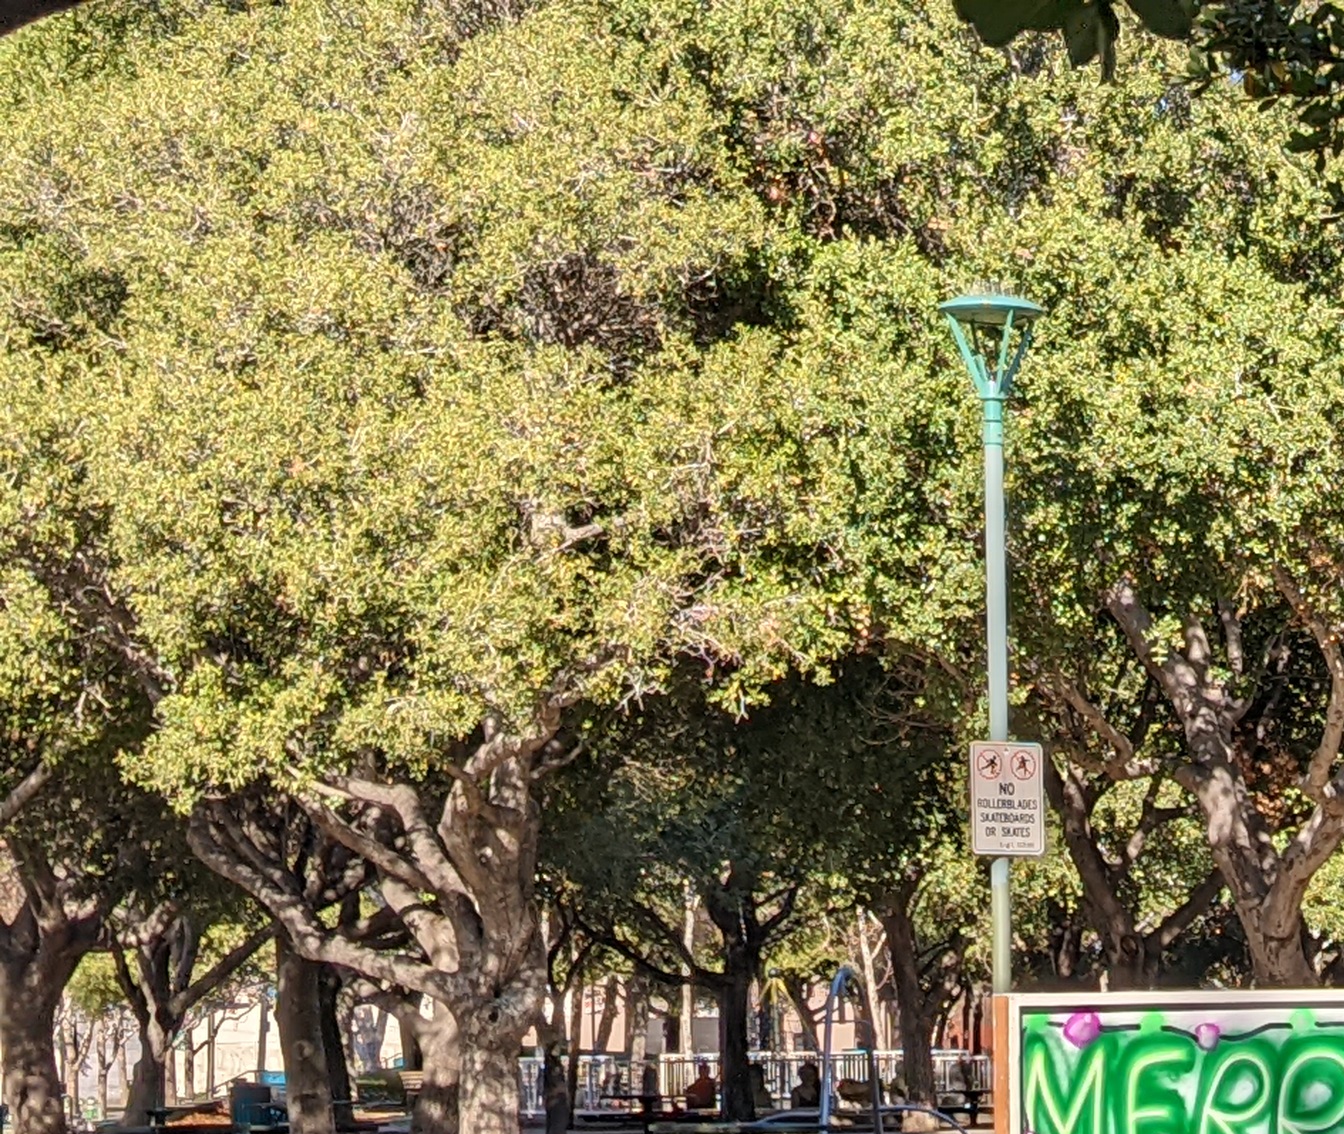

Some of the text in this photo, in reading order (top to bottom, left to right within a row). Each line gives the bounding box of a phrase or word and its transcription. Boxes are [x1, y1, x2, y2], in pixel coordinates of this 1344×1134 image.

[999, 782, 1015, 796] NO
[977, 798, 1038, 810] ROLLERBLADES
[980, 812, 1035, 824] SKATEBOARDS
[986, 826, 1030, 838] OR SKATES
